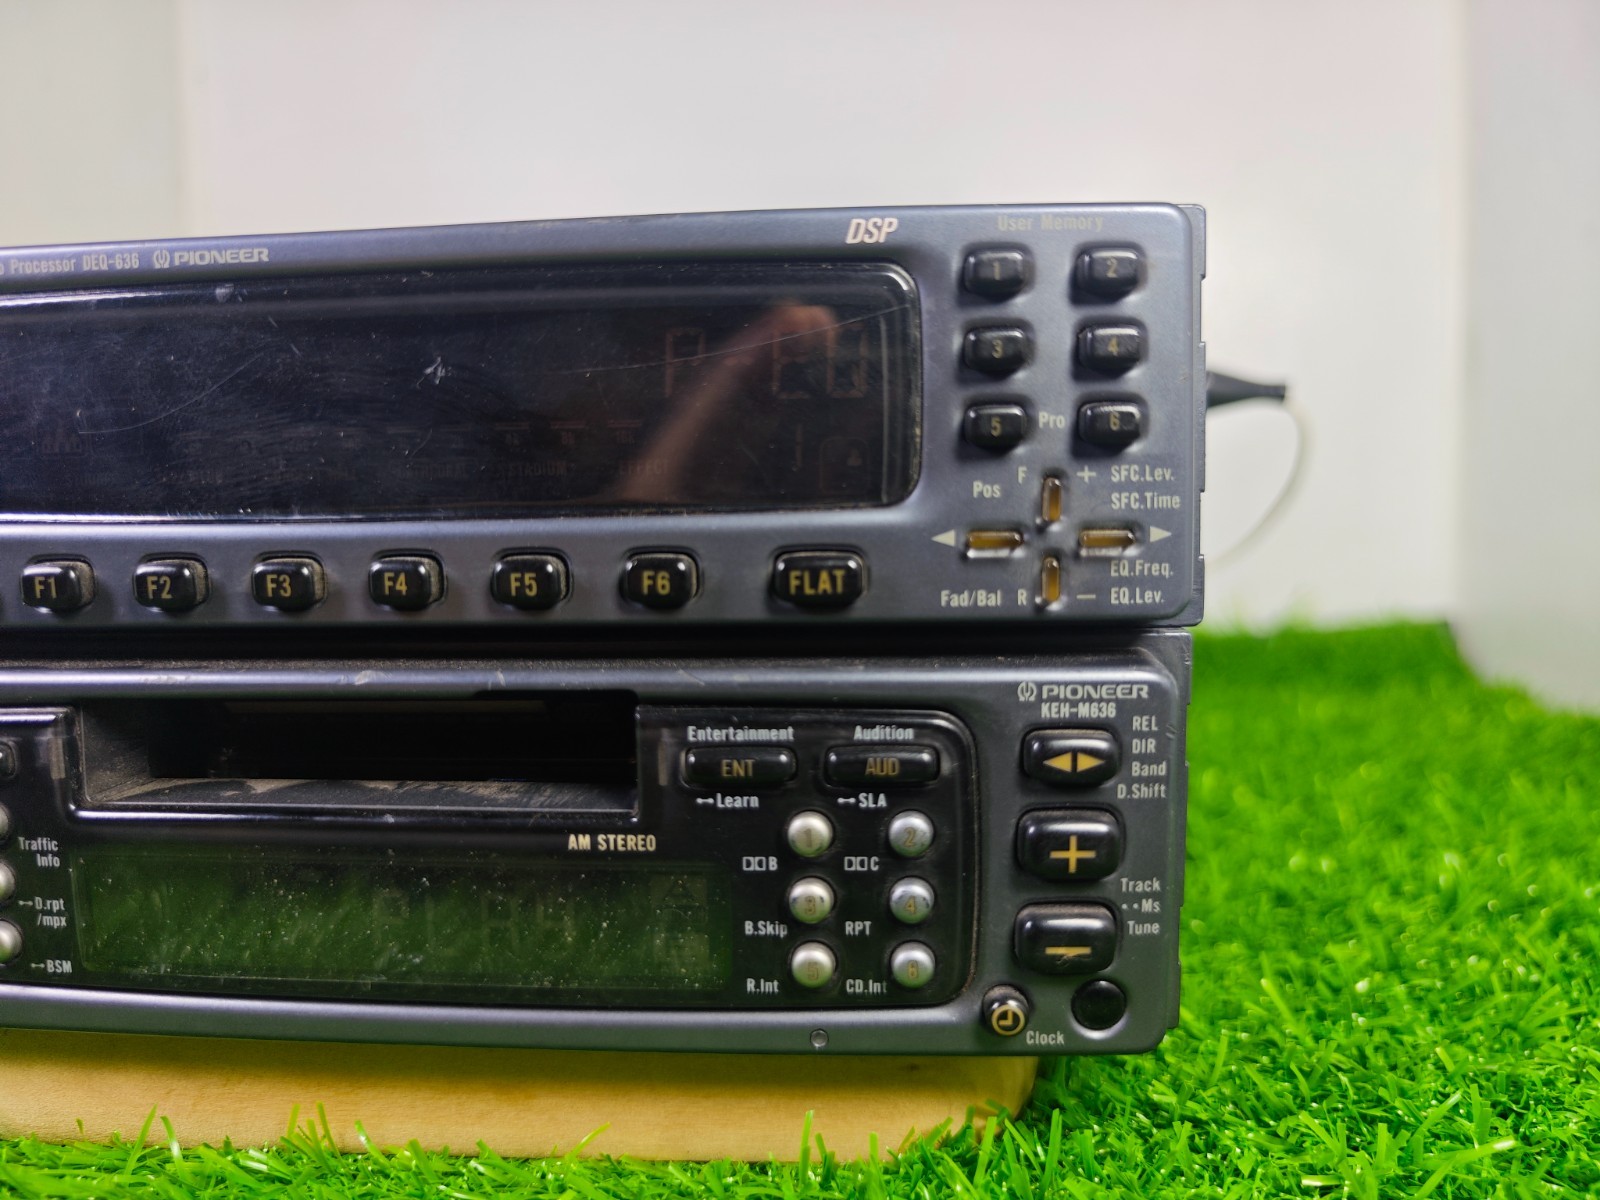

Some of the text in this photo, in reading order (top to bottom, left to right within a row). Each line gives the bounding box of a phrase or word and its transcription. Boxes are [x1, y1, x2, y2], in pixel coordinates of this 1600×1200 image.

[845, 217, 898, 244] DSP
[997, 213, 1104, 233] User Memory
[11, 258, 76, 274] Processor
[83, 252, 140, 271] DEQ-636
[174, 247, 270, 266] PIONEER
[992, 260, 1001, 280] 1
[1106, 259, 1117, 278] 2
[992, 338, 1003, 359] 3
[1107, 337, 1119, 356] 4
[990, 416, 1002, 437] 5
[1038, 411, 1066, 429] Pro
[1109, 412, 1120, 431] 6
[1017, 466, 1028, 484] F
[1110, 464, 1175, 483] SFC.Lev.
[972, 481, 1001, 498] Pos
[1110, 492, 1181, 510] SFC.Time
[1110, 560, 1174, 578] EQ.Freq.
[34, 576, 58, 600] F1
[146, 575, 173, 599] F2
[266, 573, 292, 597] F3
[383, 572, 408, 596] F4
[510, 571, 538, 597] F5
[642, 570, 671, 595] F6
[789, 569, 847, 595] FLAT
[940, 590, 1002, 608] Fad/Bal
[1017, 589, 1028, 606] R
[1110, 588, 1165, 606] EQ.Lev.
[1041, 684, 1149, 700] PIONEER
[1041, 702, 1117, 719] KEH-M636
[853, 725, 915, 741] Audition
[1132, 716, 1159, 732] REL
[687, 725, 795, 742] Entertainment
[1132, 739, 1157, 755] DIR
[721, 759, 755, 777] ENT
[865, 757, 900, 776] AUD
[1131, 761, 1168, 777] Band
[858, 793, 888, 808] SLA
[1117, 783, 1167, 800] D.Shift
[716, 793, 760, 809] Learn
[18, 837, 60, 852] Traffic
[567, 834, 657, 852] AM STEREO
[803, 828, 814, 848] 1
[904, 826, 917, 847] 2
[36, 853, 61, 868] Info
[1121, 877, 1162, 892] Track
[34, 896, 66, 913] D.rpt
[805, 896, 817, 916] 3
[905, 896, 918, 916] 4
[36, 913, 68, 929] /mpx
[744, 920, 789, 939] B.Skip
[845, 920, 873, 937] RPT
[1127, 920, 1161, 936] Tune
[46, 959, 73, 974] BSM
[806, 961, 820, 981] 5
[906, 960, 919, 980] 6
[746, 978, 780, 994] R.Int
[846, 978, 888, 994] CD.Int
[1025, 1029, 1065, 1046] Clock
